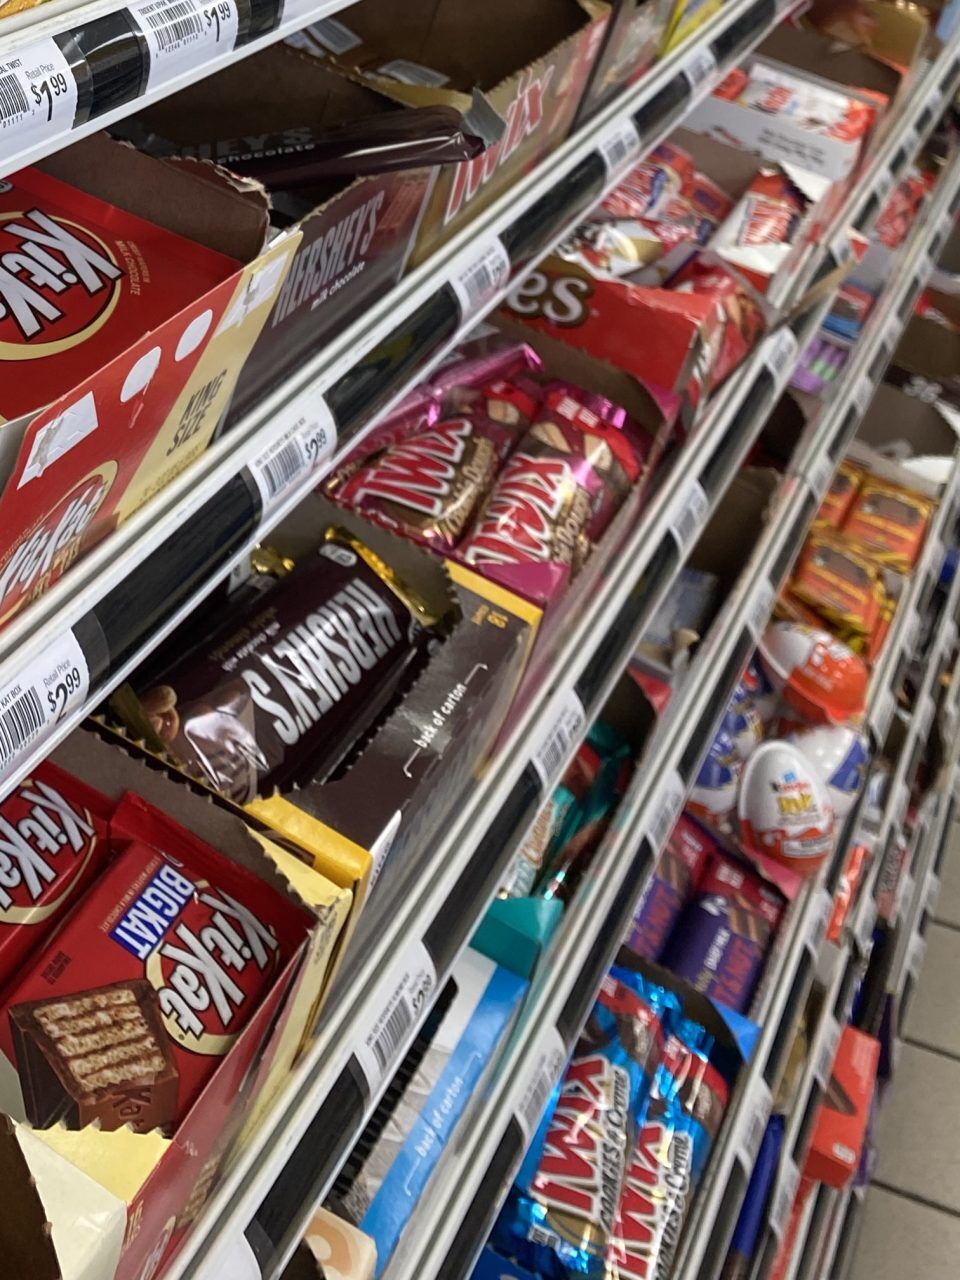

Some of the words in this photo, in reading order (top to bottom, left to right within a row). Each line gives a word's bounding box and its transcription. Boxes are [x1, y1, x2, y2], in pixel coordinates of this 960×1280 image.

[272, 190, 385, 329] HERSHEY'S
[165, 404, 207, 457] SIZE
[185, 369, 228, 418] KING
[0, 694, 13, 709] KAT
[11, 684, 23, 699] BOX
[241, 577, 404, 747] HERSHEY'S
[415, 721, 437, 751] back
[433, 712, 444, 728] of
[440, 682, 468, 717] carton
[19, 779, 97, 856] Kit
[197, 885, 279, 972] Kit
[157, 922, 246, 1041] Kat
[414, 1132, 436, 1160] back
[439, 1076, 466, 1115] carton
